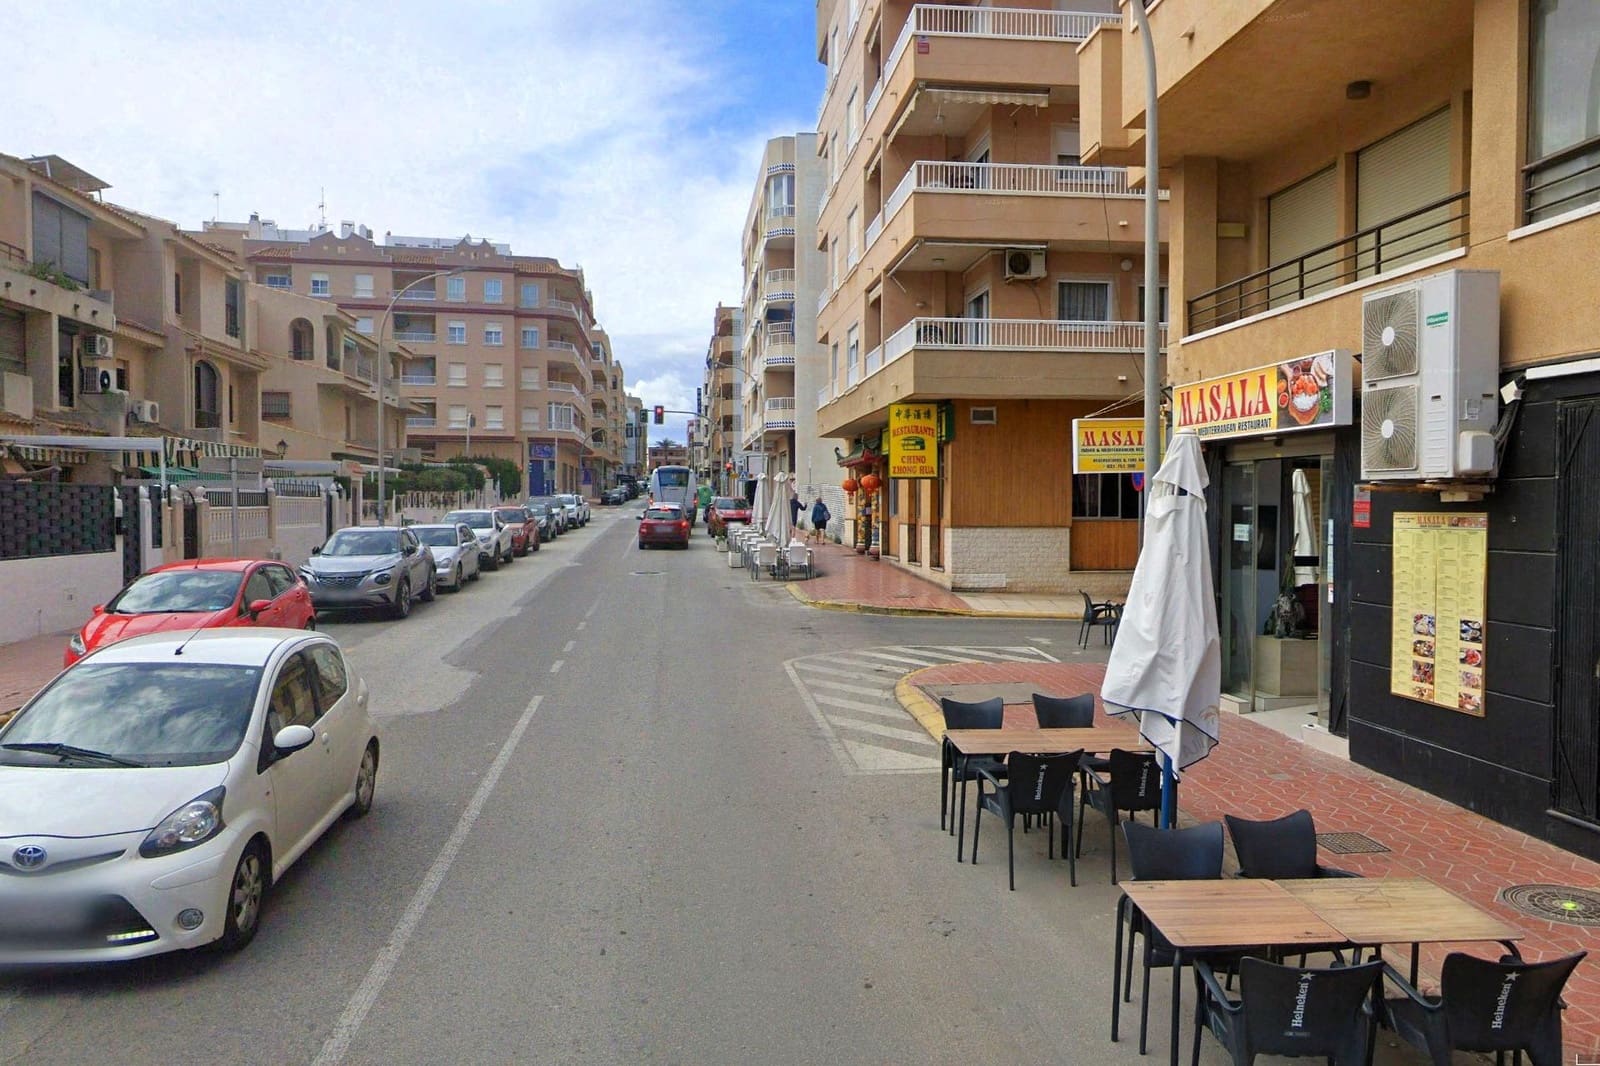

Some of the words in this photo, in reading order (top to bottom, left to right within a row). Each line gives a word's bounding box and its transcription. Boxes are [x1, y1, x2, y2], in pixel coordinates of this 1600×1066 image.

[1178, 374, 1272, 427] MASALA
[892, 425, 935, 437] RESTAURANTE
[1082, 430, 1145, 447] MASAL
[1198, 422, 1237, 436] MEDITERRANEAN
[1237, 418, 1272, 431] RESTAURANT
[892, 466, 917, 474] ZHONG
[920, 466, 935, 474] HUA
[901, 456, 926, 464] CHINO
[1034, 771, 1045, 800] Heineken
[1138, 768, 1148, 797] Heineken
[1291, 982, 1309, 1028] Heineken
[1491, 982, 1512, 1028] Heineken
